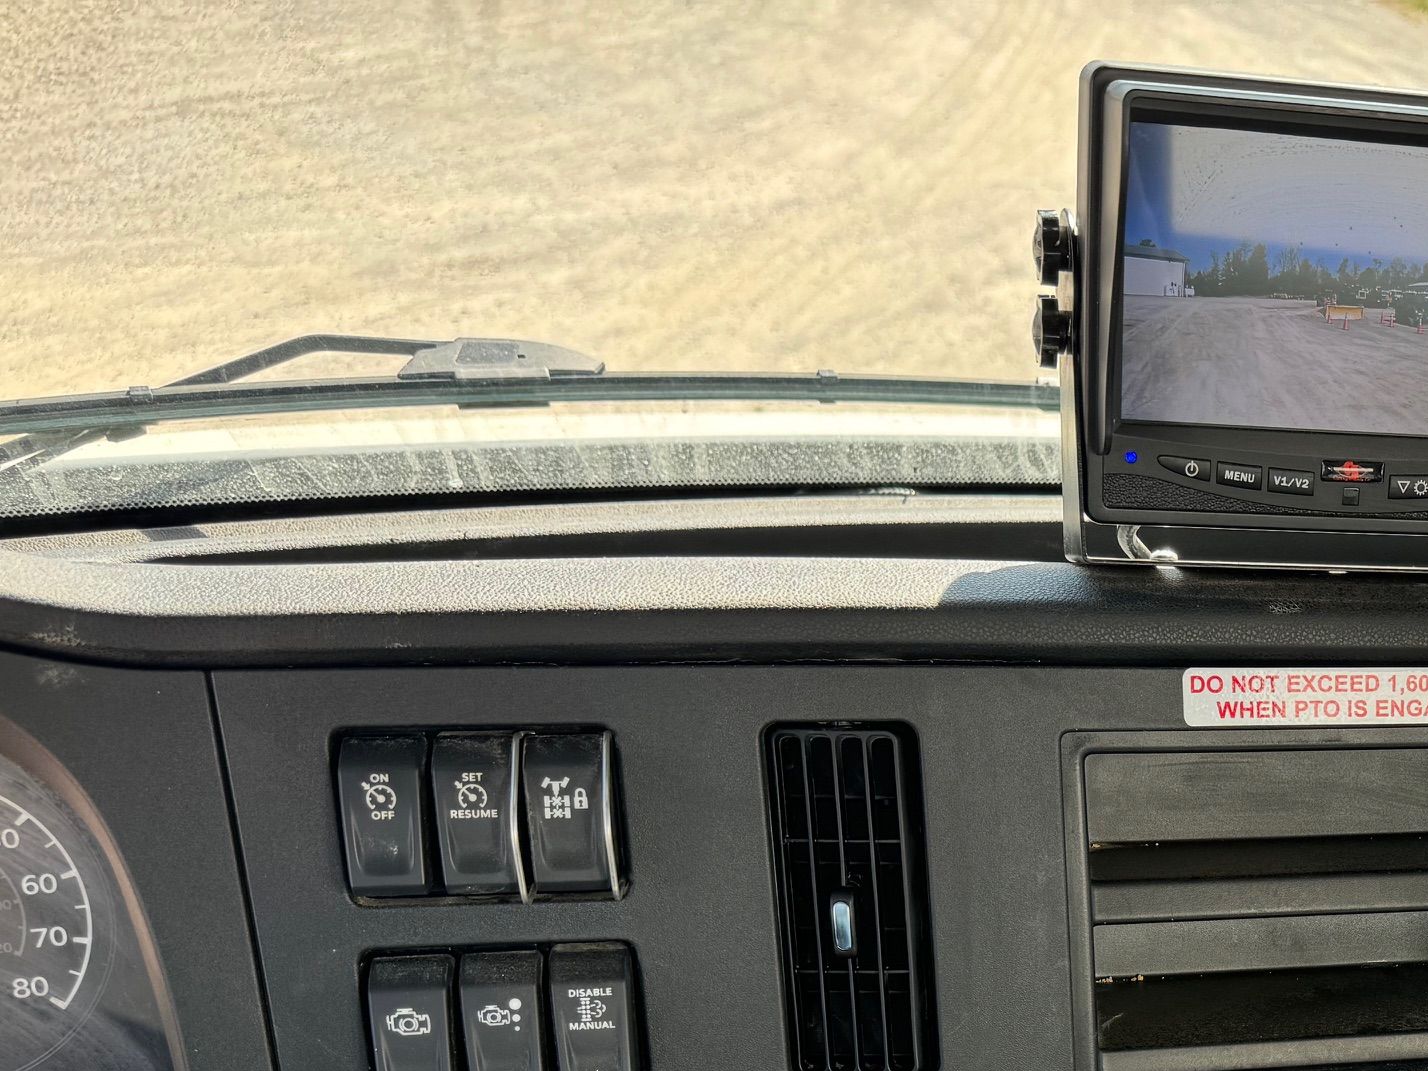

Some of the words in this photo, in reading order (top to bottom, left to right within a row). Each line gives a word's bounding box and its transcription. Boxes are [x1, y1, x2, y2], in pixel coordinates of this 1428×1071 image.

[1224, 470, 1255, 483] MENU
[1273, 475, 1310, 489] V1/V2
[1190, 675, 1223, 694] DO
[1231, 674, 1279, 693] NOT
[1286, 674, 1380, 693] EXCEED
[1216, 701, 1286, 719] WHEN
[1294, 700, 1340, 718] PTO
[1348, 700, 1368, 717] IS
[369, 773, 389, 783] ON
[461, 772, 483, 782] SET
[371, 810, 395, 820] OFF
[450, 809, 498, 818] RESUME
[0, 829, 20, 849] 0
[21, 873, 58, 895] 60
[30, 926, 68, 948] 70
[12, 976, 49, 999] 80
[568, 987, 612, 998] DISABLE
[569, 1021, 616, 1031] MANUAL
